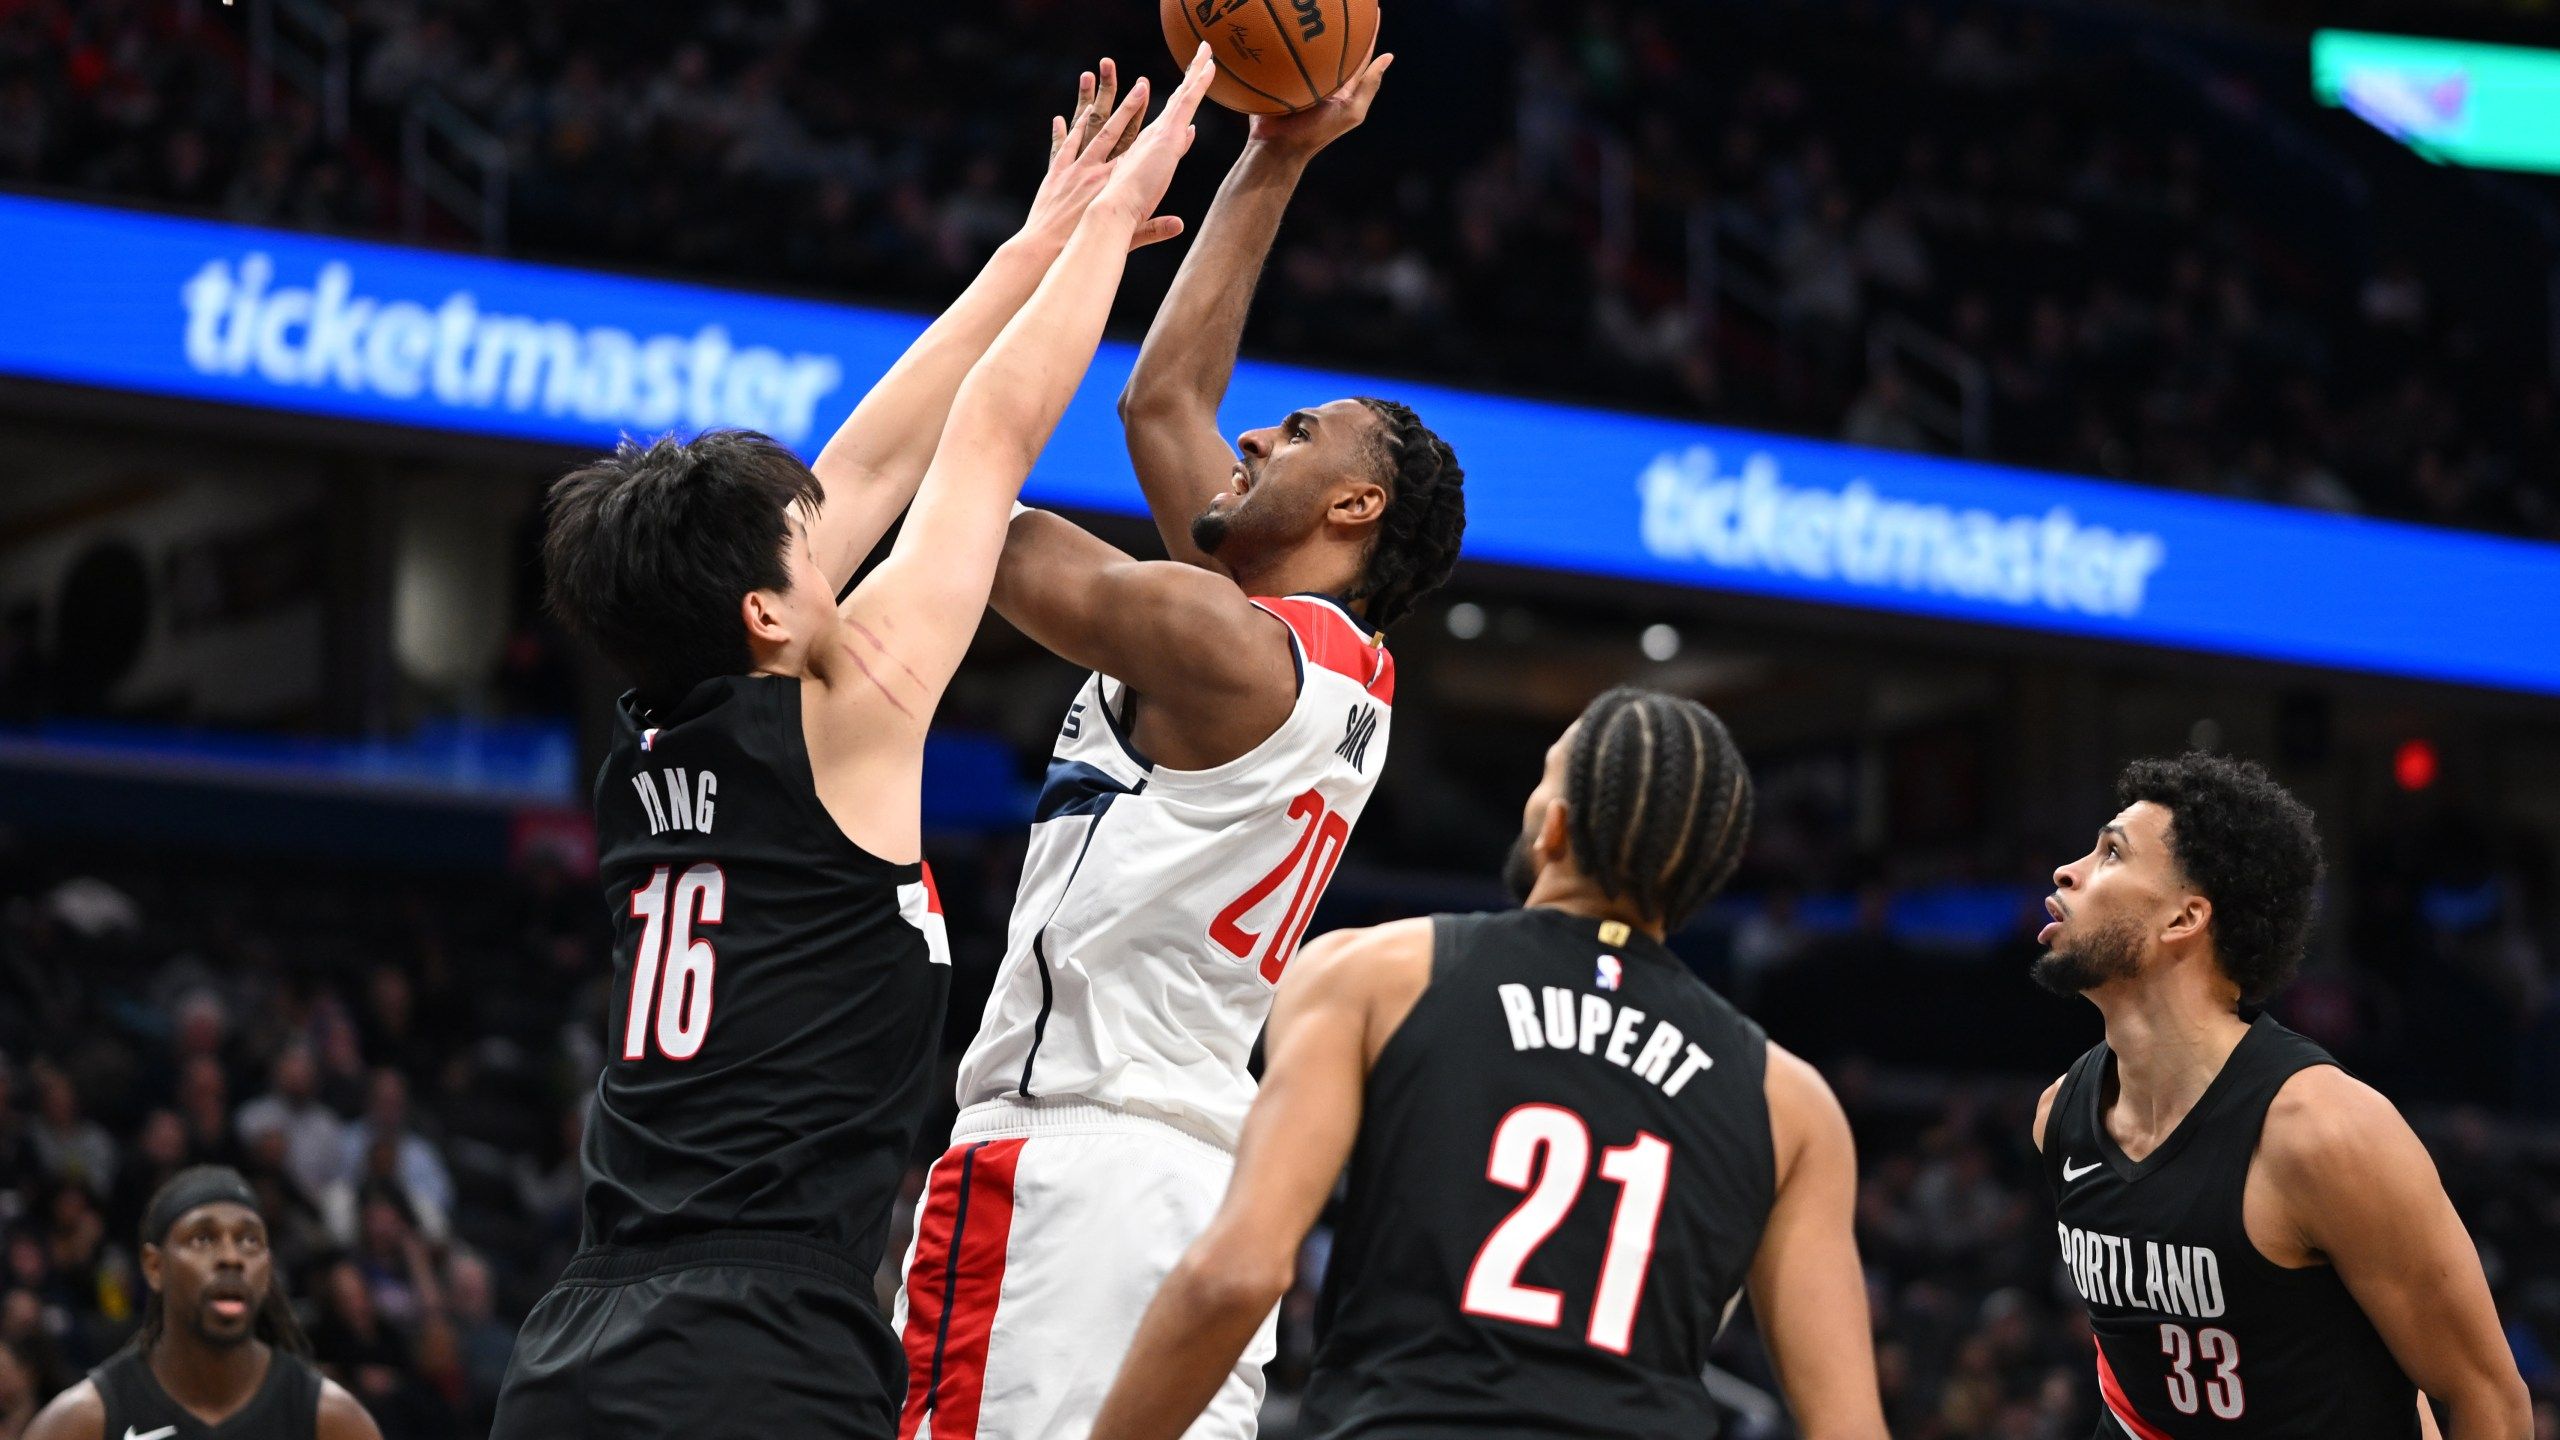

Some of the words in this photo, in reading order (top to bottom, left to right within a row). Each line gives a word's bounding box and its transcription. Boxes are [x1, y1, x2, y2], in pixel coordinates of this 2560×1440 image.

[182, 252, 844, 438] ticketmaster
[1638, 445, 2164, 618] ticketmaster
[631, 767, 717, 835] YANG
[1205, 787, 1350, 985] 20
[623, 862, 726, 1061] 16
[1498, 983, 1714, 1097] RUPERT
[1461, 1102, 1673, 1356] 21
[2057, 1220, 2226, 1318] PORTLAND
[2159, 1322, 2245, 1421] 33
